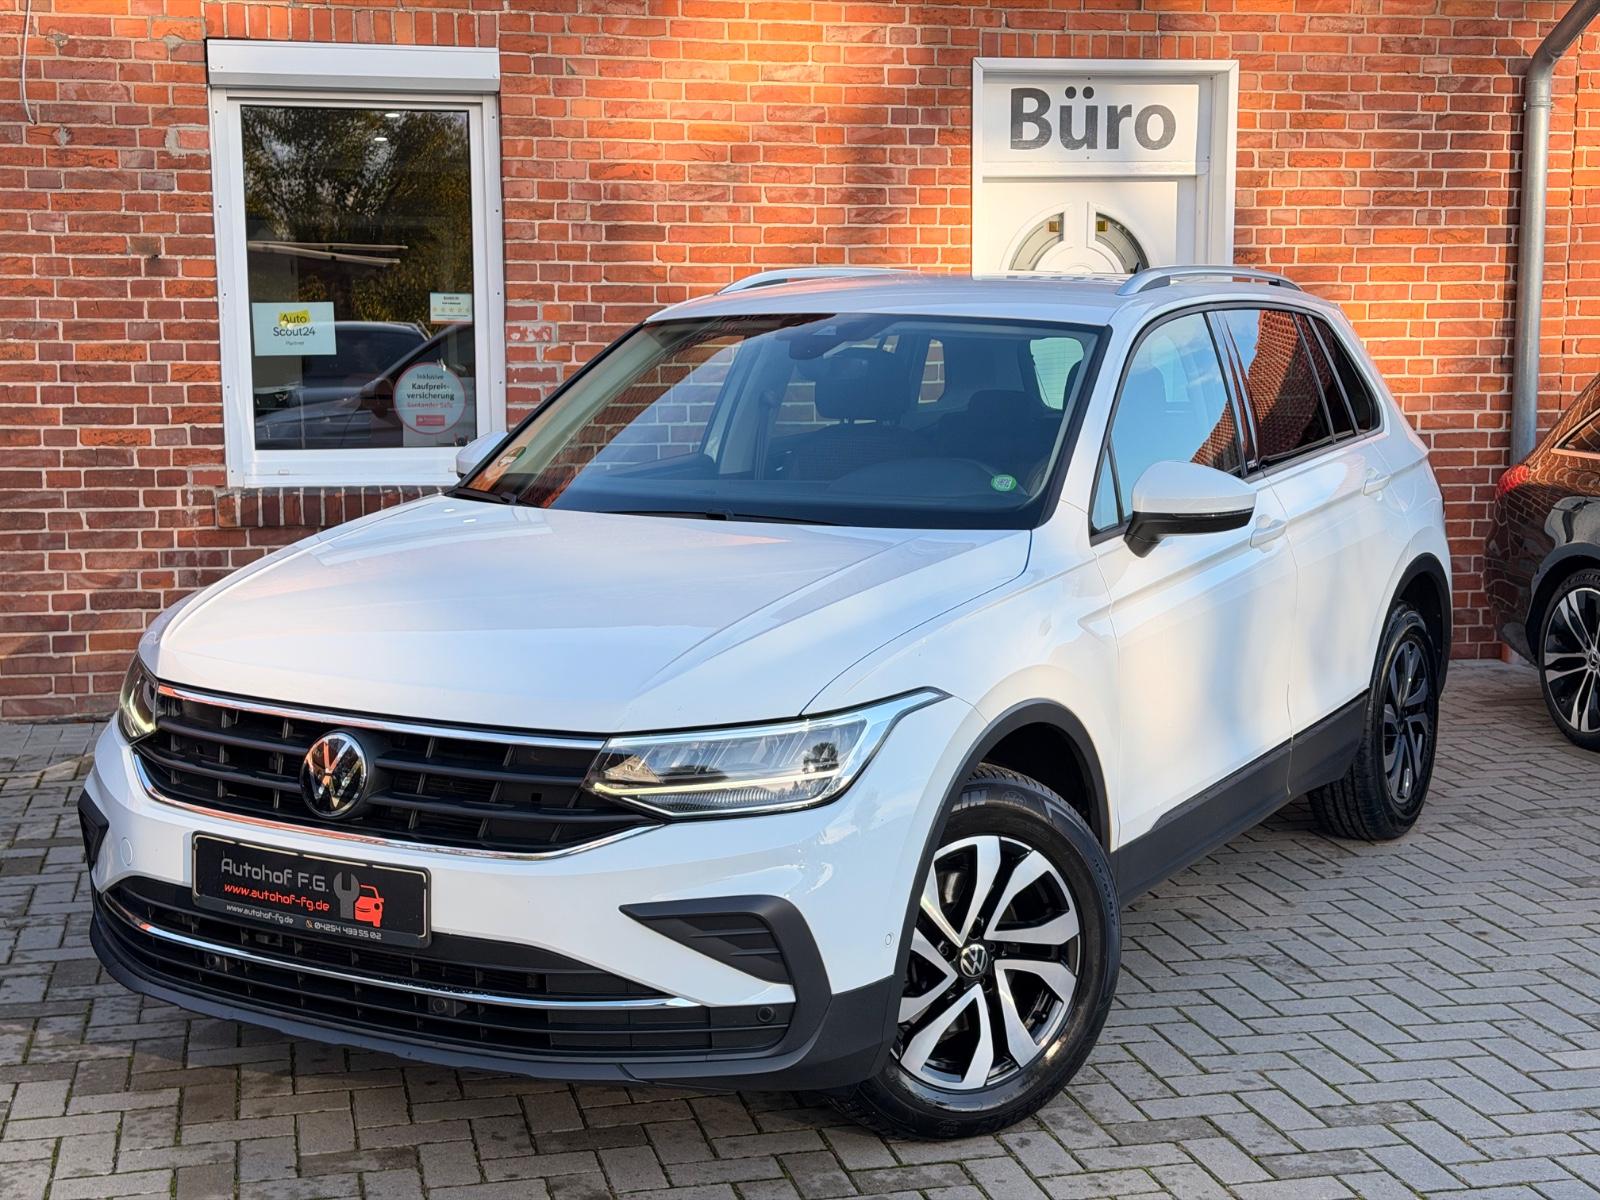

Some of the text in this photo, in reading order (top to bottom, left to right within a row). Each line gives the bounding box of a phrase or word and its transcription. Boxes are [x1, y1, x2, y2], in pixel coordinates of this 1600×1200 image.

[1010, 86, 1177, 151] Büro
[282, 313, 308, 324] Auto
[272, 326, 316, 337] Scout24
[411, 382, 450, 391] Kaufpreis-
[406, 392, 455, 401] versicherung
[221, 858, 330, 893] Autohof F.G.
[223, 883, 331, 912] www.autohof-fg.de
[226, 904, 294, 925] www.autohof-fg.de
[314, 921, 382, 940] 04254 433 55 02
